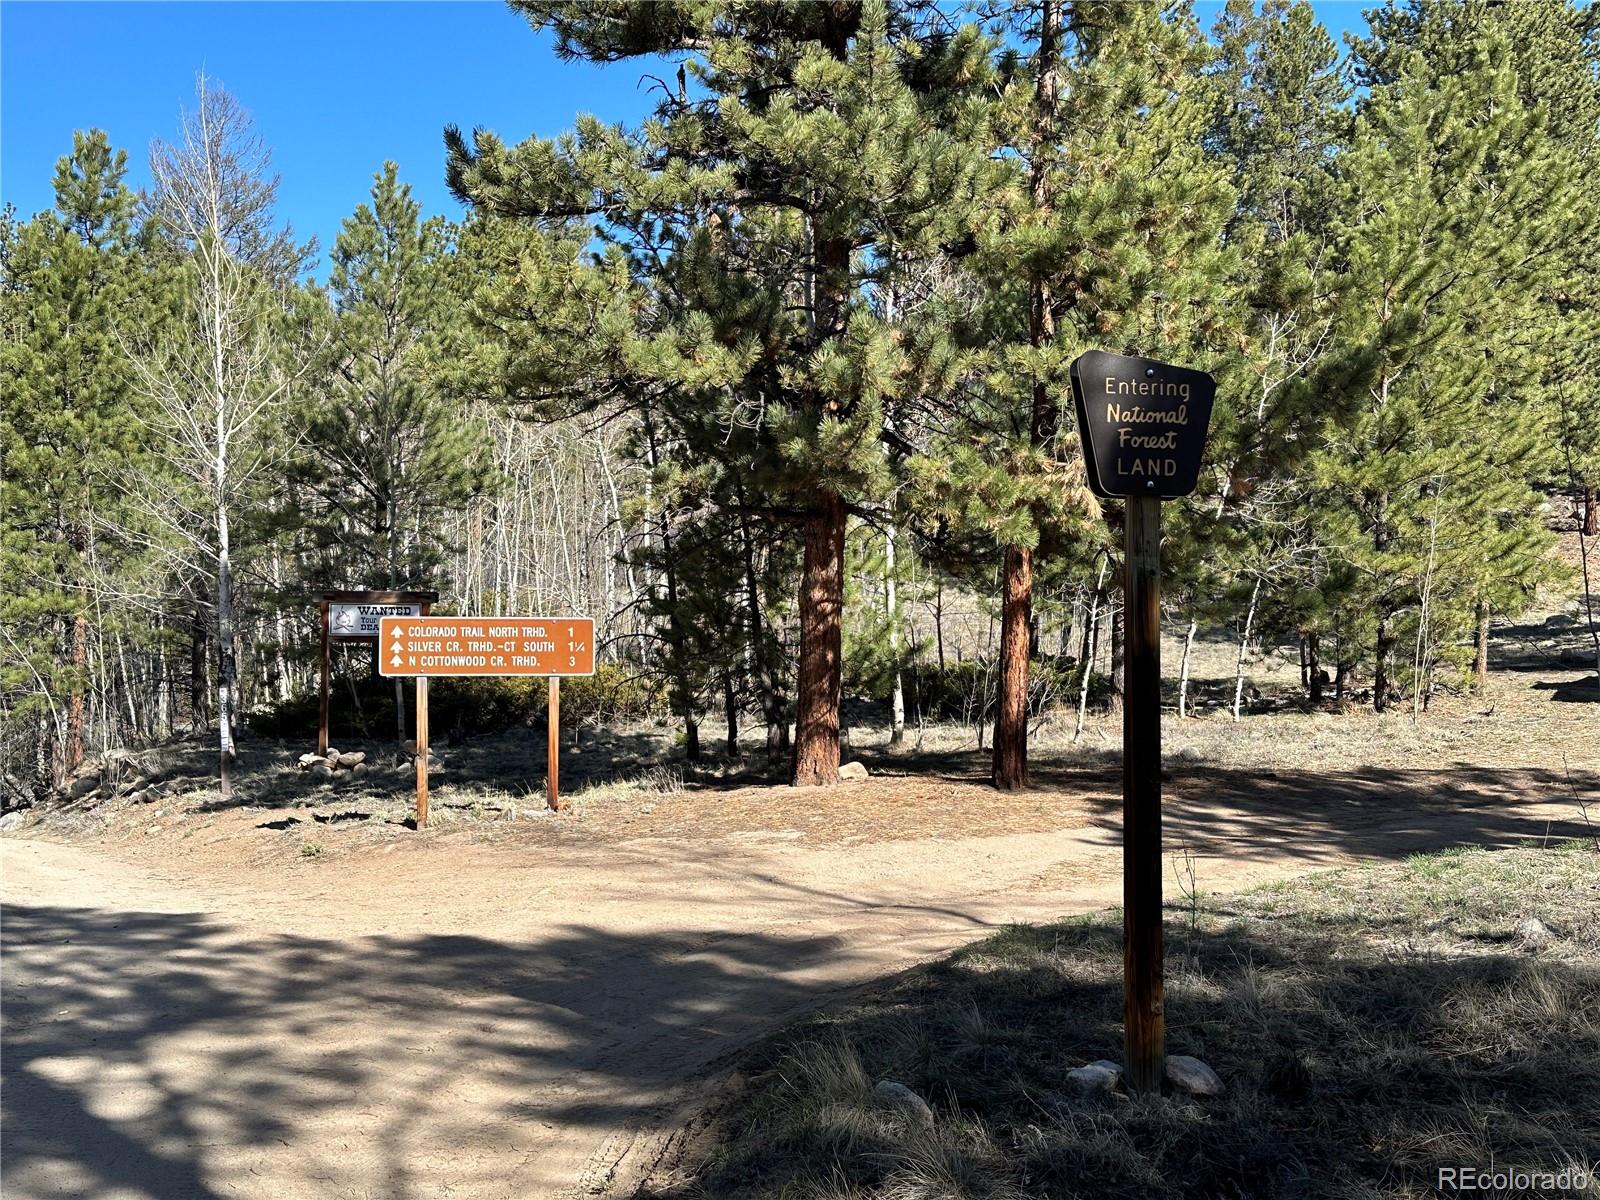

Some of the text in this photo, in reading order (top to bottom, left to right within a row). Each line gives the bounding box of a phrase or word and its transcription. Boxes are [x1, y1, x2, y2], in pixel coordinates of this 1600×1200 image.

[1105, 377, 1190, 402] Entering
[1106, 403, 1188, 425] National
[1117, 427, 1179, 450] Forest
[1117, 458, 1177, 477] LAND
[357, 606, 412, 616] WANTED
[360, 616, 377, 624] Your
[408, 626, 574, 638] COLORADO TRAIL NORTH TRHD. 1
[407, 641, 442, 652] SILVER
[446, 641, 463, 652] CR.
[523, 641, 555, 652] SOUTH
[408, 655, 576, 667] N COTTONWOOD CR. TRHD. 3
